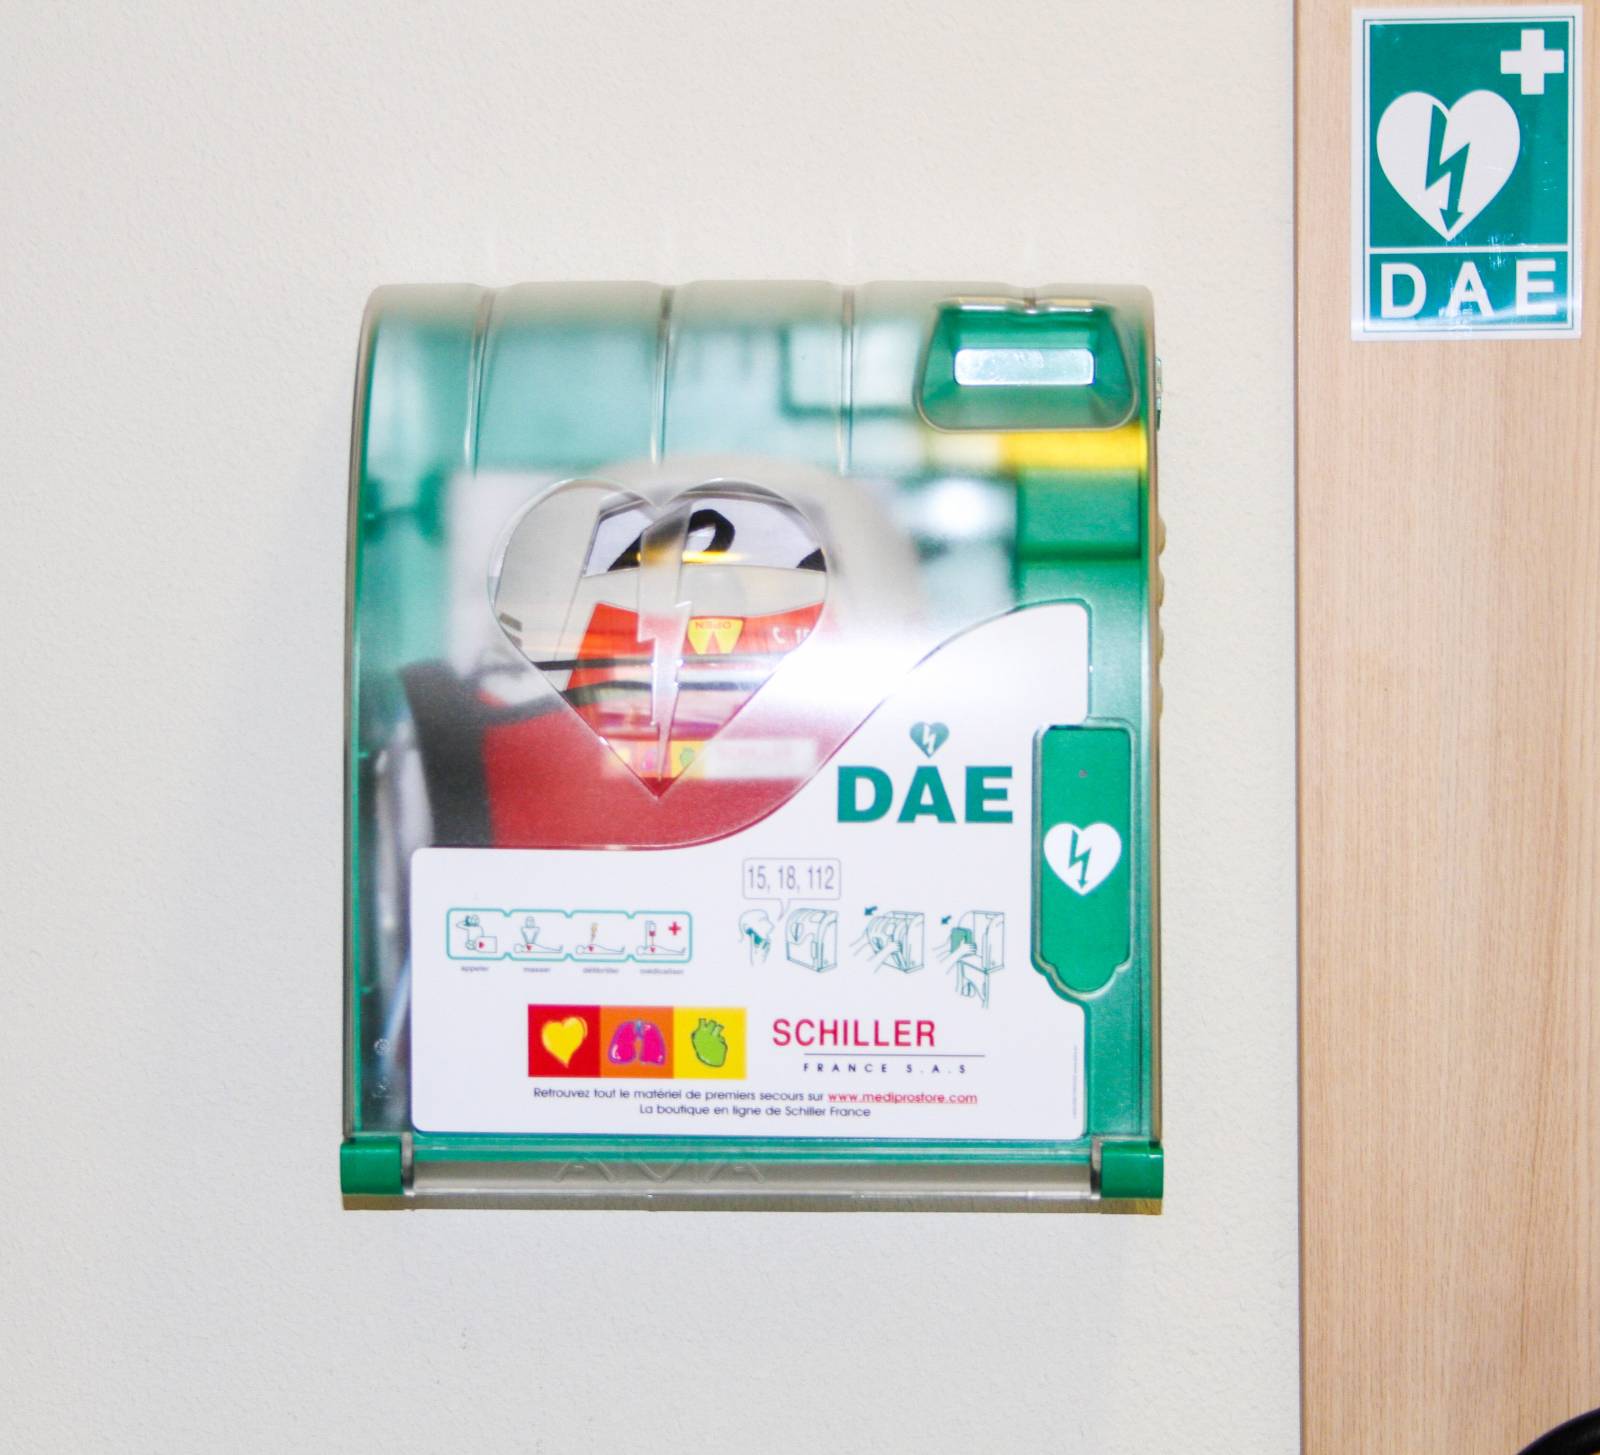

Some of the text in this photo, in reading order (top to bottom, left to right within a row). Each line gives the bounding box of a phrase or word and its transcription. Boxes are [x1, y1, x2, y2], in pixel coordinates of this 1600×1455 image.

[1380, 258, 1557, 319] DAE
[837, 765, 1013, 824] DAE
[748, 864, 835, 893] 15, 18, 112
[772, 1018, 936, 1047] SCHILLER
[803, 1062, 888, 1074] FRANCE
[533, 1087, 978, 1104] Retrouvez tout le matériel de premiers secours sur www.mediprostore.com
[639, 1103, 654, 1114] La
[657, 1104, 710, 1116] boutique
[733, 1105, 762, 1117] ligne
[765, 1105, 782, 1115] de
[785, 1105, 827, 1116] Schiller
[830, 1106, 872, 1117] France
